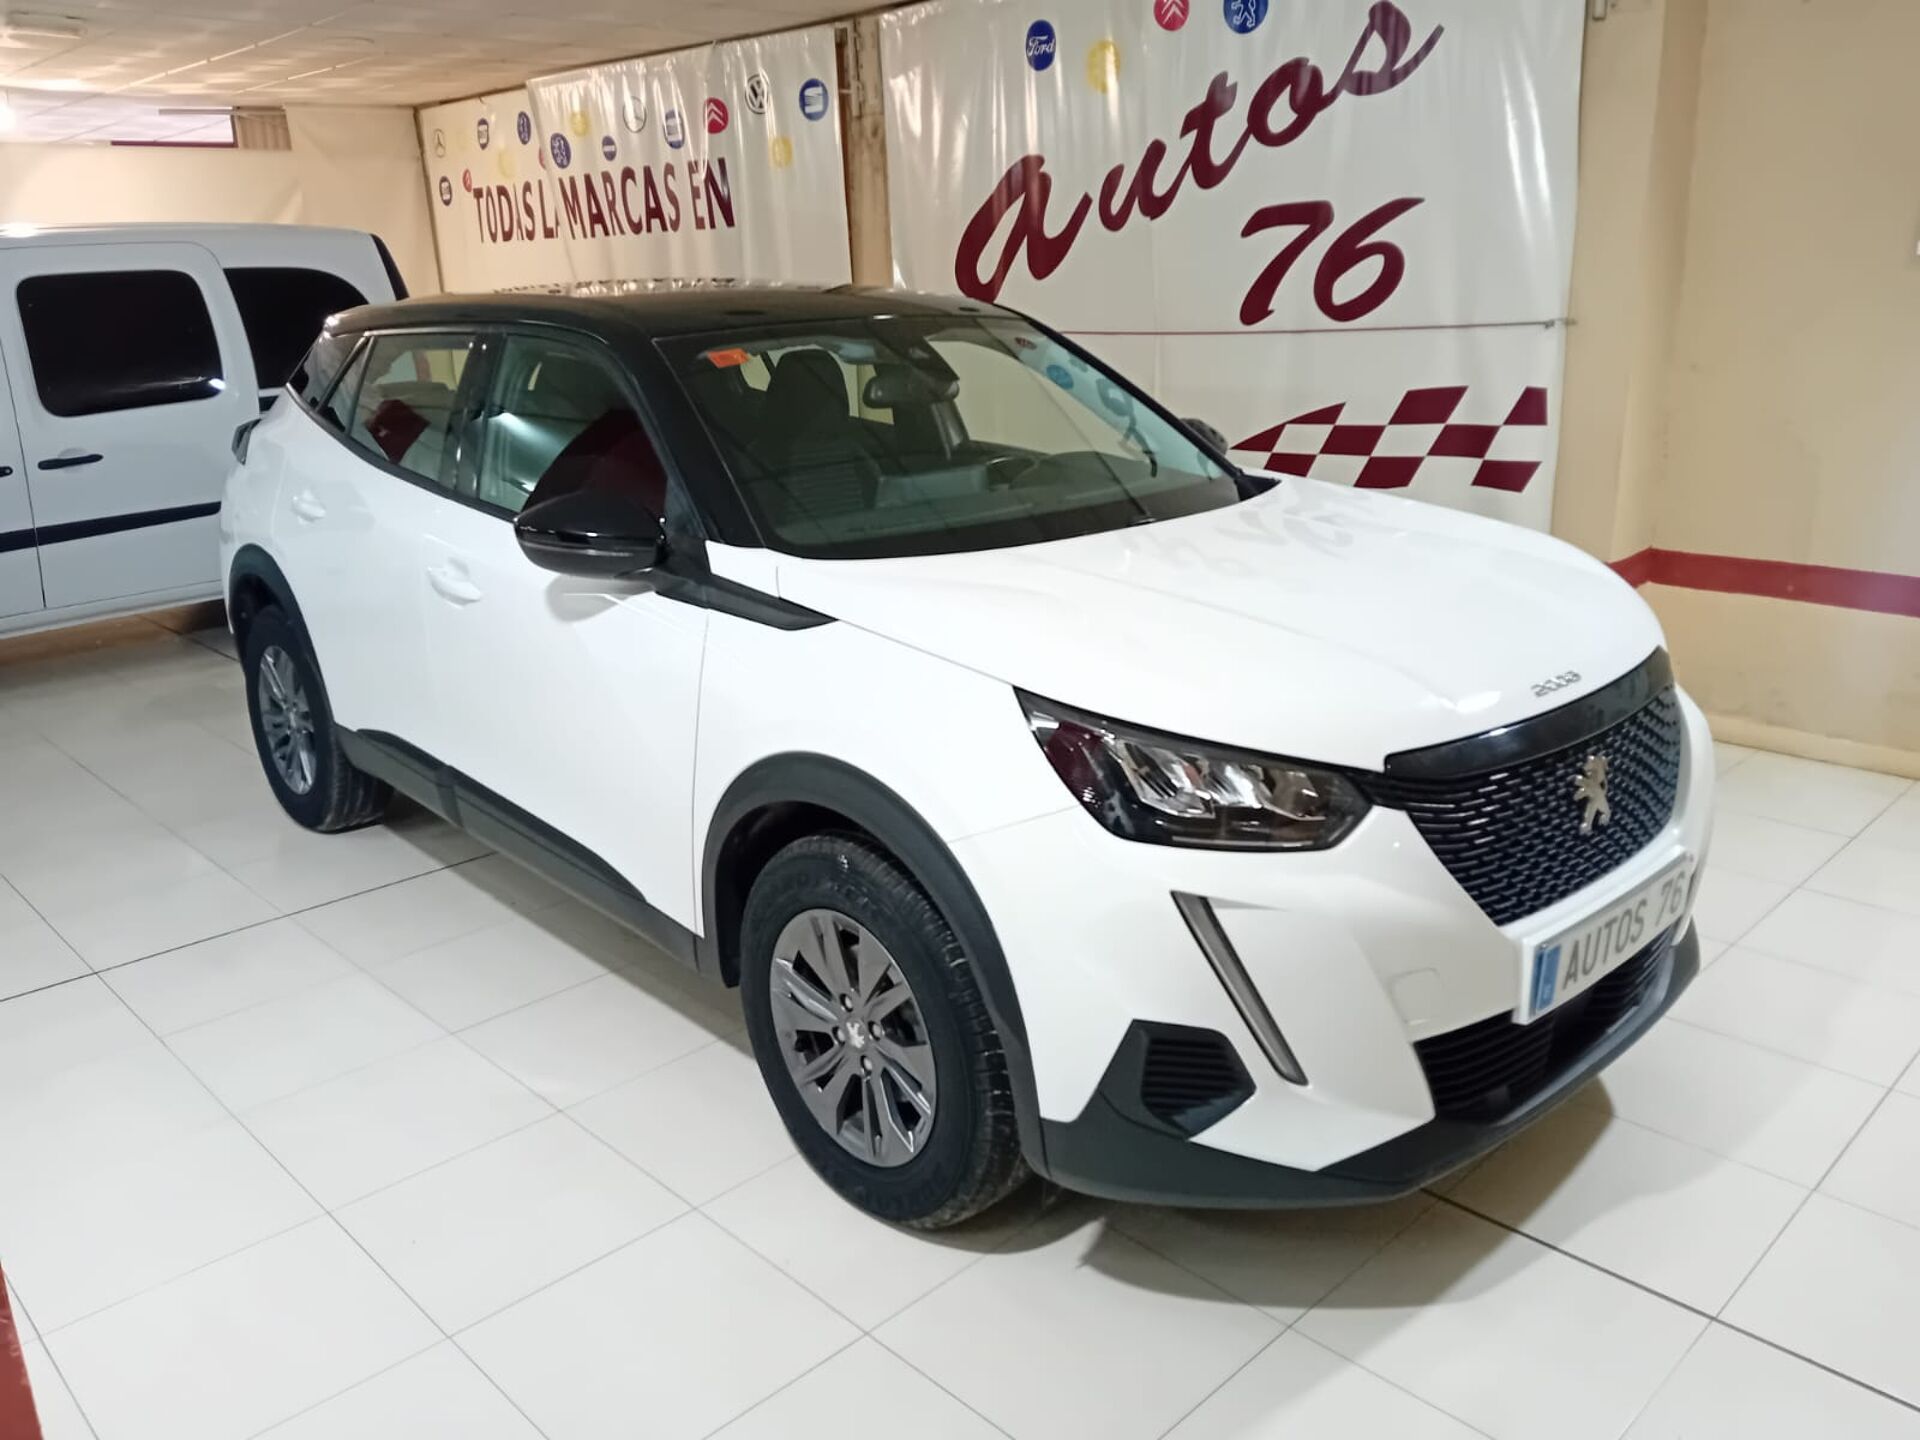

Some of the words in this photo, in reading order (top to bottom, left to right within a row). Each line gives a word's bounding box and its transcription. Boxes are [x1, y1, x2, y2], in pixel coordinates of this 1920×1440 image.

[1025, 36, 1057, 56] Ford
[472, 180, 536, 244] TODAS
[539, 175, 560, 239] L
[558, 161, 681, 240] MARCAS
[687, 156, 735, 231] EN
[1239, 197, 1426, 326] 76
[1531, 671, 1582, 697] 2008
[1562, 898, 1647, 990] AUTOS
[1655, 870, 1687, 927] 76
